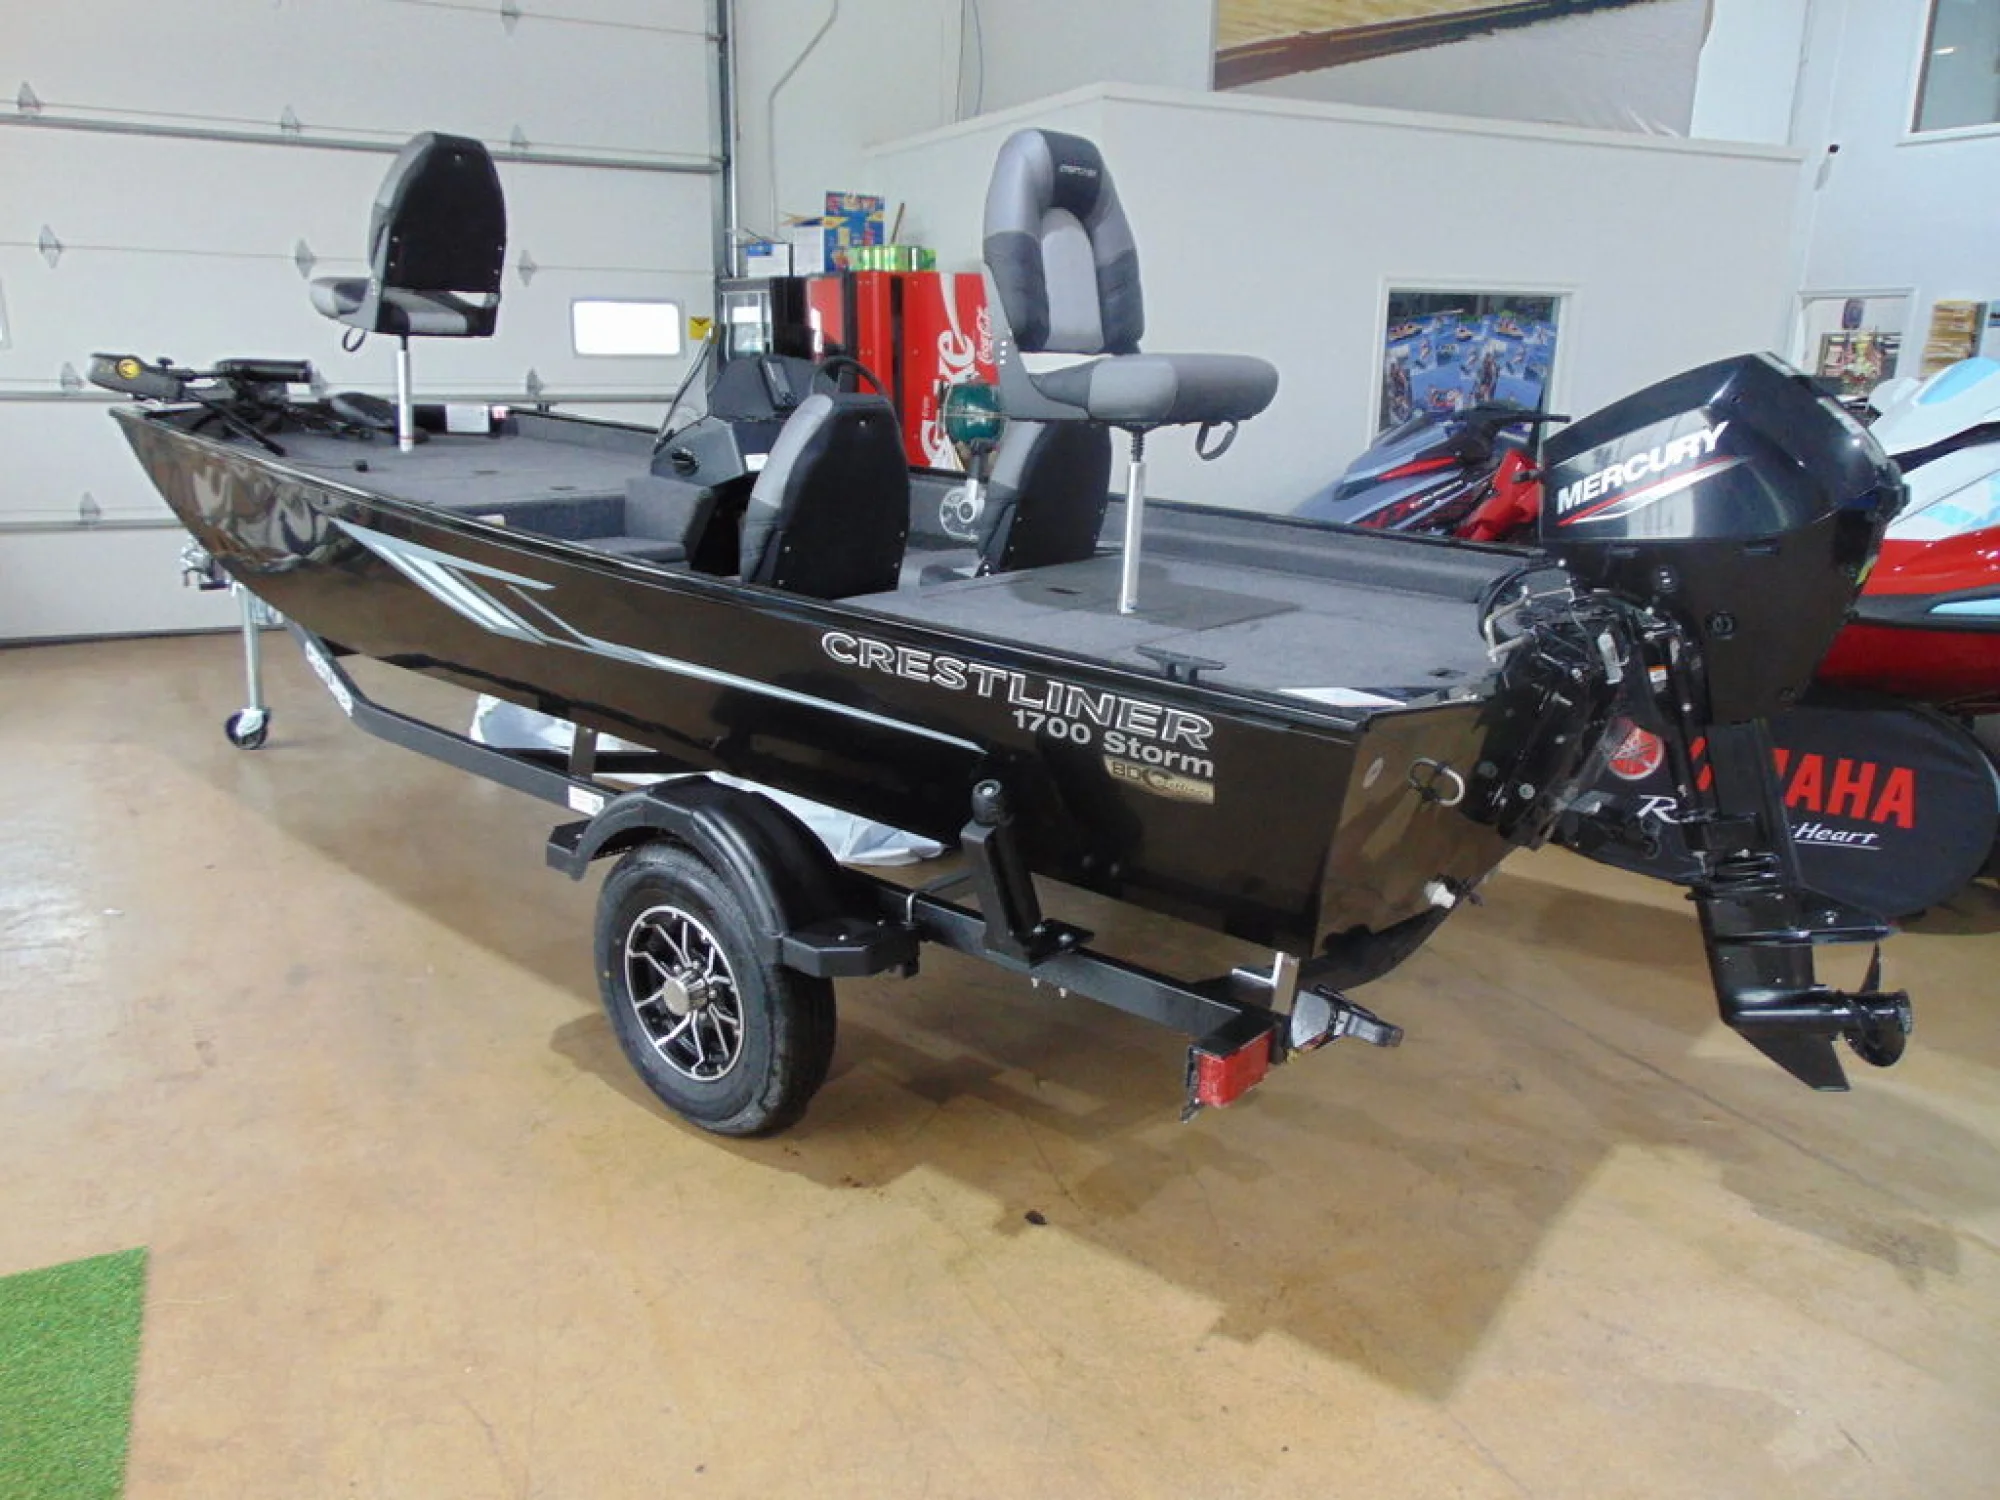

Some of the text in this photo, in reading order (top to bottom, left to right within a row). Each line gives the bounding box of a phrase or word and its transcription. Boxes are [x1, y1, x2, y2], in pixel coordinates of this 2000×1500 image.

[1556, 420, 1731, 515] MERCURY
[821, 631, 1213, 750] CRESTLINER
[1012, 709, 1214, 778] 1700 Storm
[1792, 821, 1879, 846] Heart
